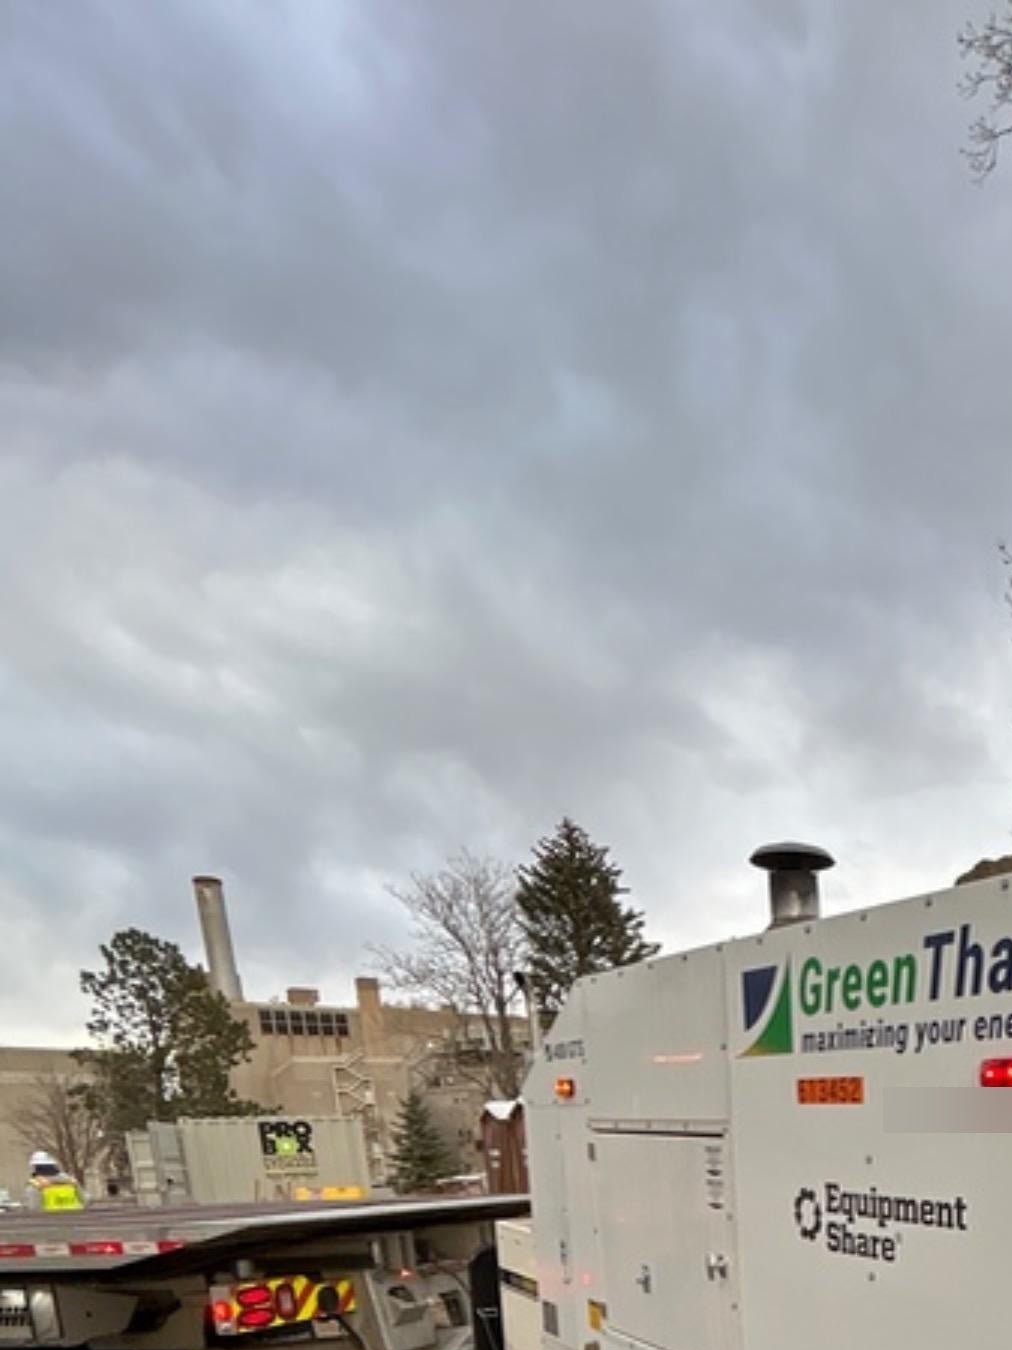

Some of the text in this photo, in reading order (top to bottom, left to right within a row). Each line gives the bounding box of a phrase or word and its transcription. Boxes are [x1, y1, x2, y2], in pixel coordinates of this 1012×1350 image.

[802, 1020, 908, 1055] maximizing
[915, 1018, 966, 1053] your
[258, 1120, 313, 1137] PRO
[825, 1182, 967, 1231] Equipment
